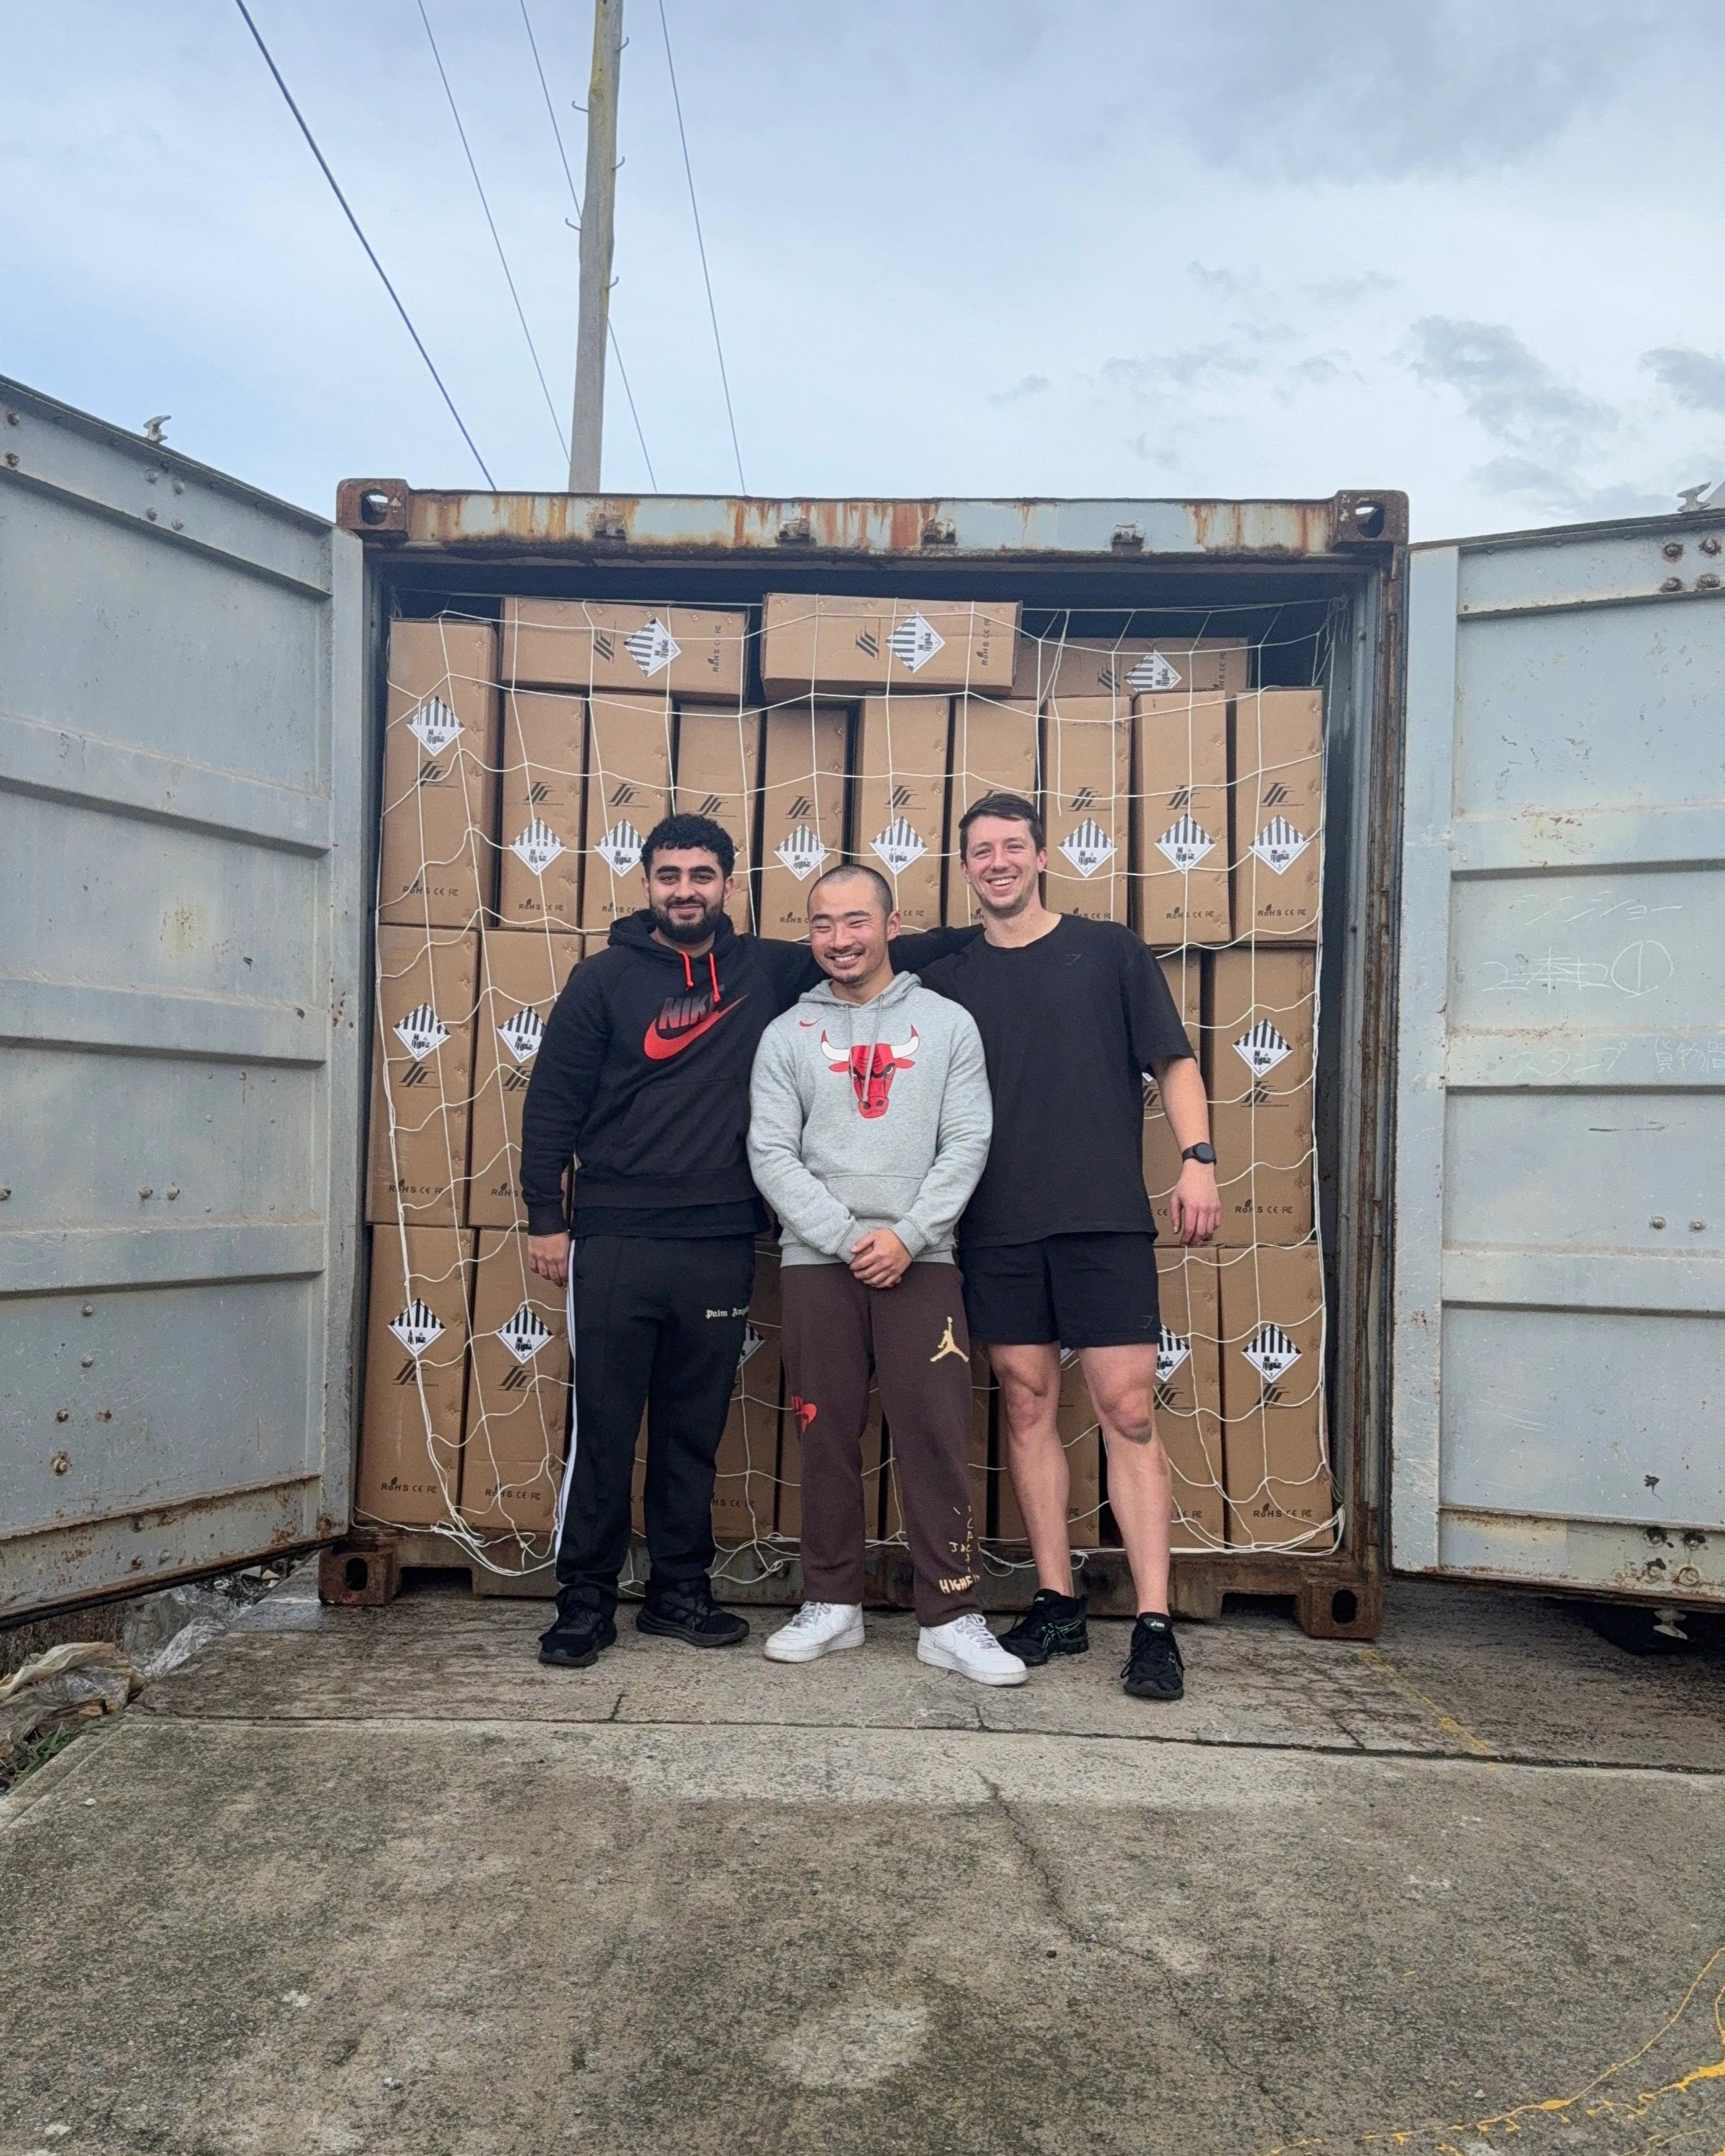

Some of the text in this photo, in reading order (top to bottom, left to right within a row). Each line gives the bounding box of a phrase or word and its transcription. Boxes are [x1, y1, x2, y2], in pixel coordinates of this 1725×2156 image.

[982, 629, 991, 639] CE
[433, 887, 445, 896] CE
[1509, 1041, 1628, 1079] スタンプ
[419, 1186, 431, 1194] CE
[705, 1305, 749, 1319] Palm Ang
[412, 1484, 423, 1493] CE
[516, 1490, 527, 1500] CE
[729, 1499, 741, 1508] CE
